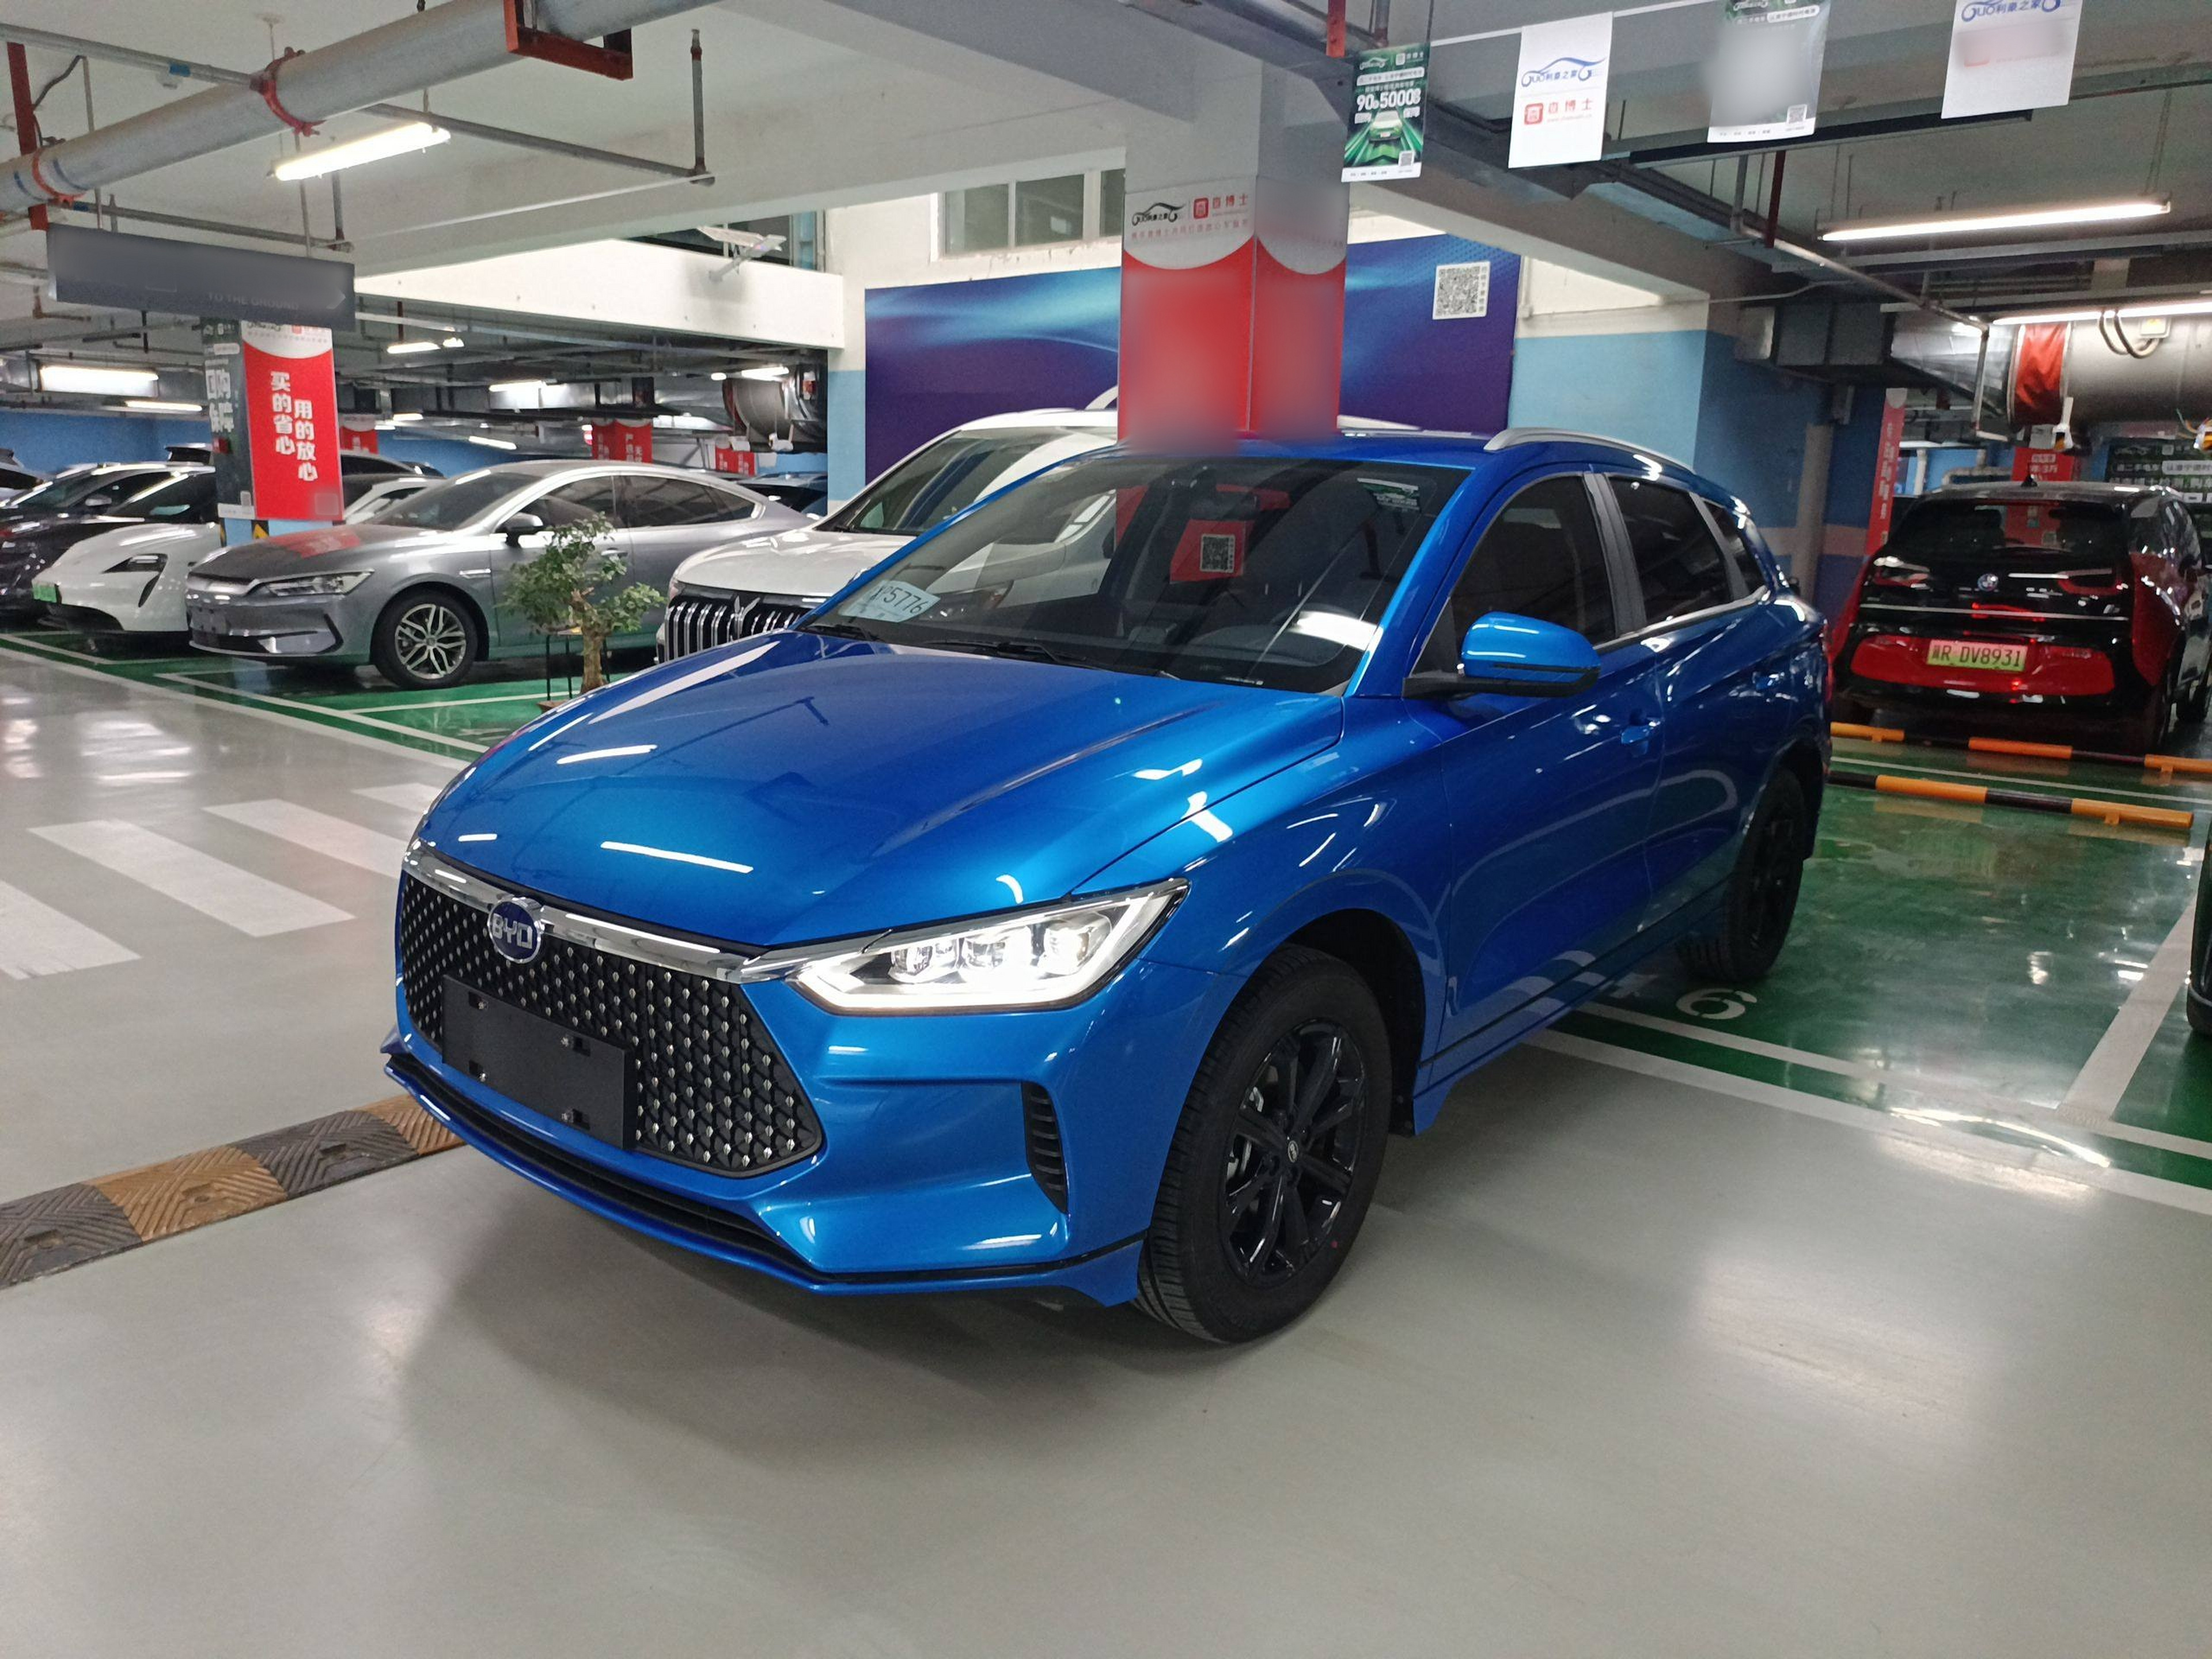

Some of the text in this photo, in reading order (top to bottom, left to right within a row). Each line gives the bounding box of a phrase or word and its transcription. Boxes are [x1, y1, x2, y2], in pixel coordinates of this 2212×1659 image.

[228, 296, 248, 305] THE
[271, 371, 295, 454] 买的省心
[294, 399, 318, 481] 用的放心
[1960, 646, 2020, 667] DV8931
[493, 912, 533, 949] BYD
